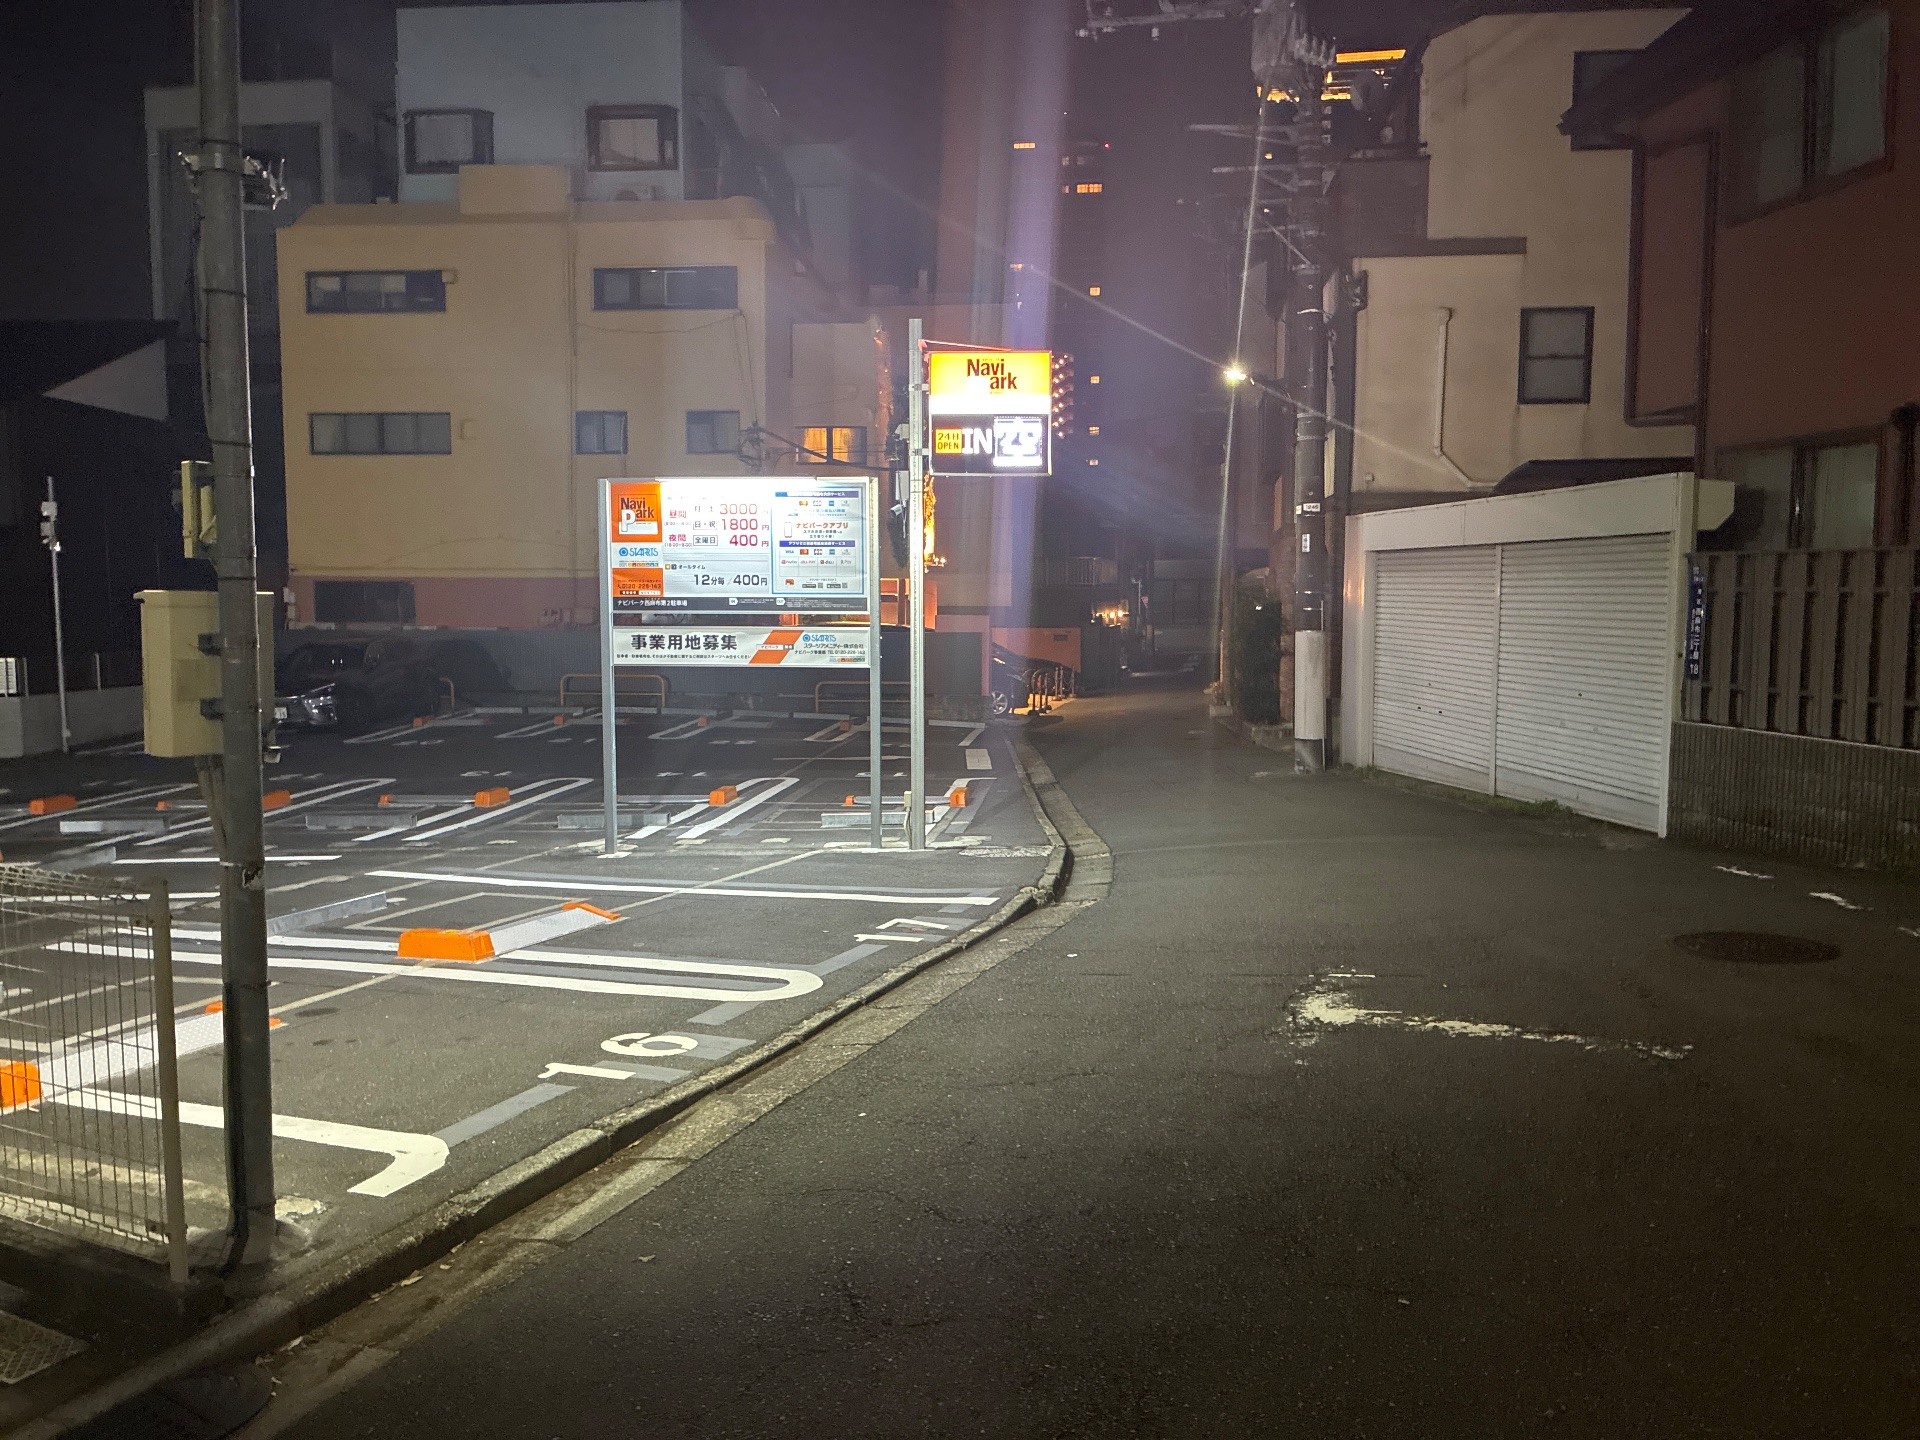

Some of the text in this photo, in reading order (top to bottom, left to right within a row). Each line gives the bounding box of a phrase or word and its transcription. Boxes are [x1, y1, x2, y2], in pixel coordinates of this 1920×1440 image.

[966, 358, 1005, 377] Navi
[937, 432, 960, 441] 24H
[962, 427, 993, 455] IN
[937, 441, 960, 451] OPEN
[620, 497, 646, 510] Navi
[621, 506, 655, 533] Park
[668, 533, 687, 543] 夜間
[694, 536, 717, 545] 全曜日
[629, 547, 659, 557] STARTS
[630, 634, 738, 651] 事業用地募集
[1689, 663, 1699, 675] 18
[853, 918, 950, 943] 17
[537, 1032, 699, 1079] 16
